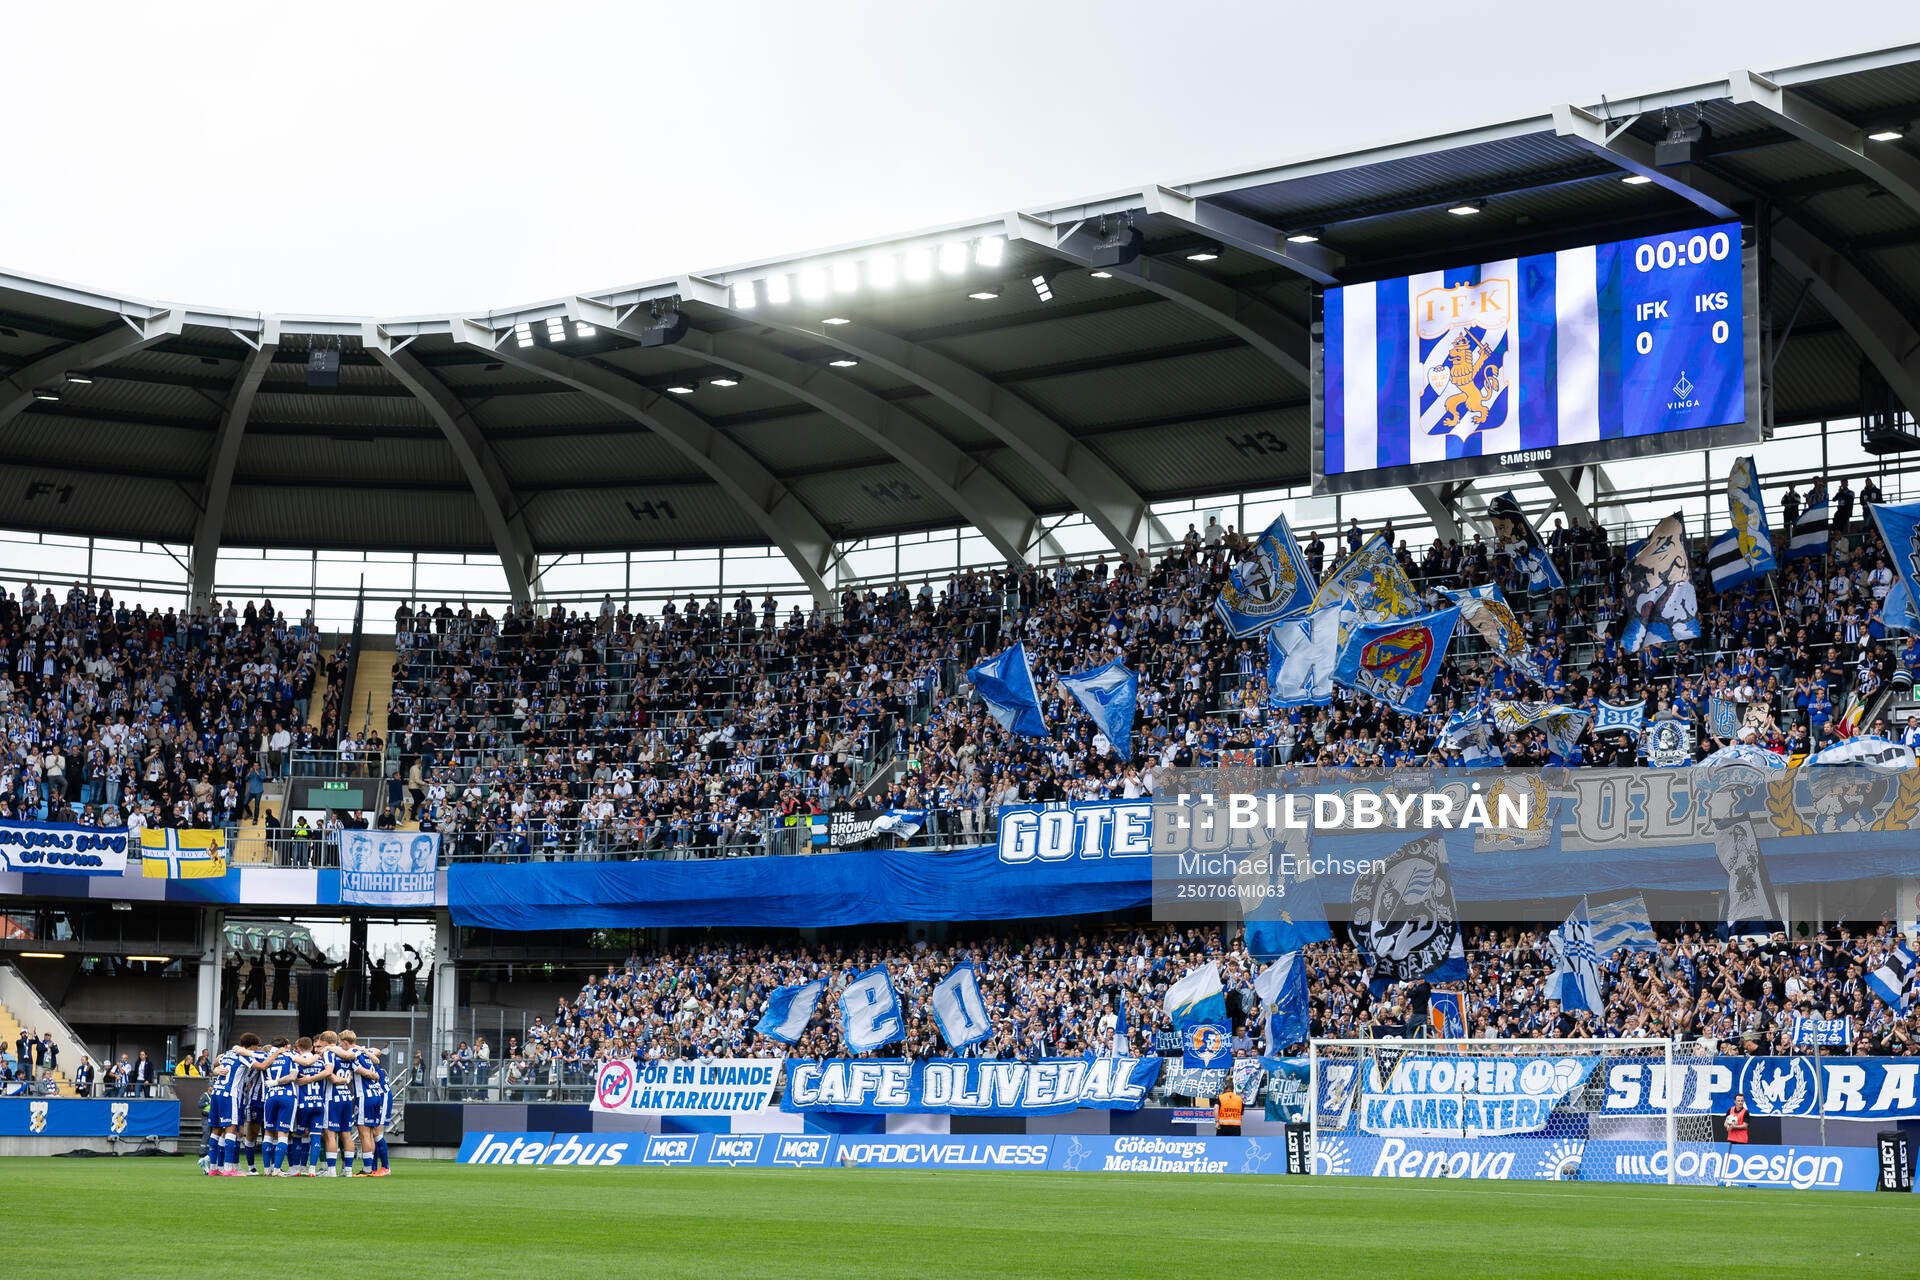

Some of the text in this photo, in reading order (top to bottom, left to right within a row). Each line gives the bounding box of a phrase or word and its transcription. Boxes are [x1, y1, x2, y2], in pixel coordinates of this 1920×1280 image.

[1635, 231, 1730, 273] 00:00
[1636, 292, 1729, 322] IFK IKS
[1636, 320, 1730, 355] 0 0
[1667, 399, 1700, 410] VINGA
[1225, 430, 1289, 459] H3
[1499, 449, 1552, 466] SAMSUNG
[24, 480, 75, 505] F1
[625, 498, 678, 522] H1
[1596, 706, 1644, 727] 1312
[831, 820, 872, 834] BROWN
[832, 811, 856, 823] THE
[831, 828, 879, 846] BOMBERS
[47, 852, 103, 867] TOUR
[343, 871, 435, 892] KAMRATERNA
[1802, 1019, 1844, 1033] SUP
[673, 1066, 695, 1084] EN
[700, 1066, 773, 1085] LEVANDE
[793, 1062, 913, 1107] CAFE
[922, 1058, 1144, 1107] OLIVEDAL
[1606, 1064, 1732, 1110] SUP
[469, 1134, 629, 1166] Interbus
[651, 1141, 687, 1158] MCR
[716, 1141, 753, 1158] MCR
[782, 1141, 818, 1159] MCR
[1114, 1137, 1206, 1159] Göteborgs
[1288, 1131, 1300, 1173] SELECT
[1103, 1154, 1228, 1173] Metallpartier
[1372, 1138, 1516, 1180] Renova
[1881, 1140, 1897, 1189] SELECT
[1899, 1140, 1909, 1188] SELECT
